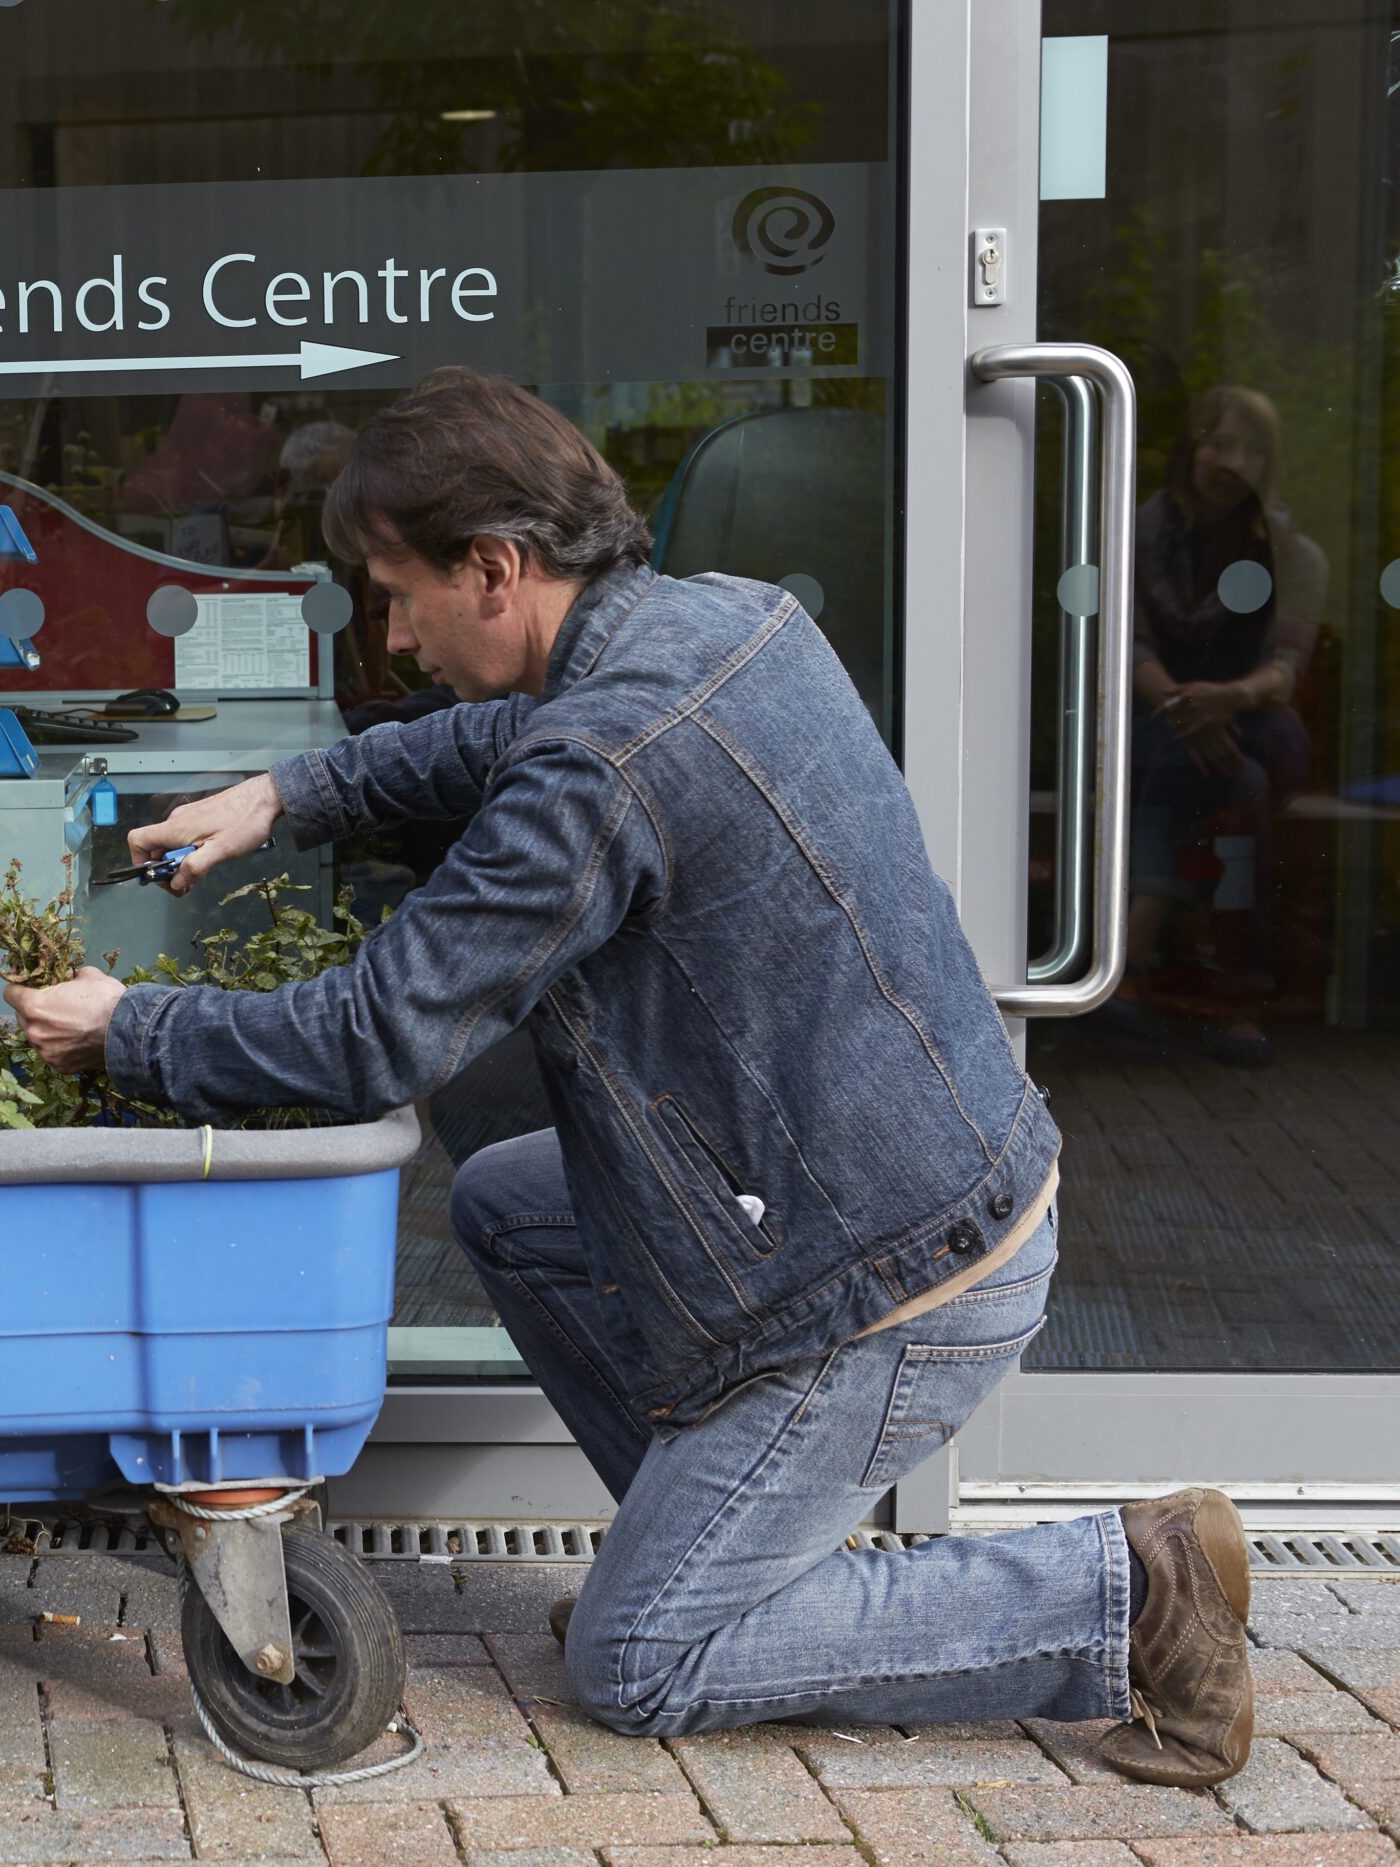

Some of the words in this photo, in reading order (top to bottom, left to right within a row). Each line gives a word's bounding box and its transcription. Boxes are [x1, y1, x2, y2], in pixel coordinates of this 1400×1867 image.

[202, 252, 499, 328] Centre
[723, 294, 841, 324] friends
[731, 328, 836, 354] centre
